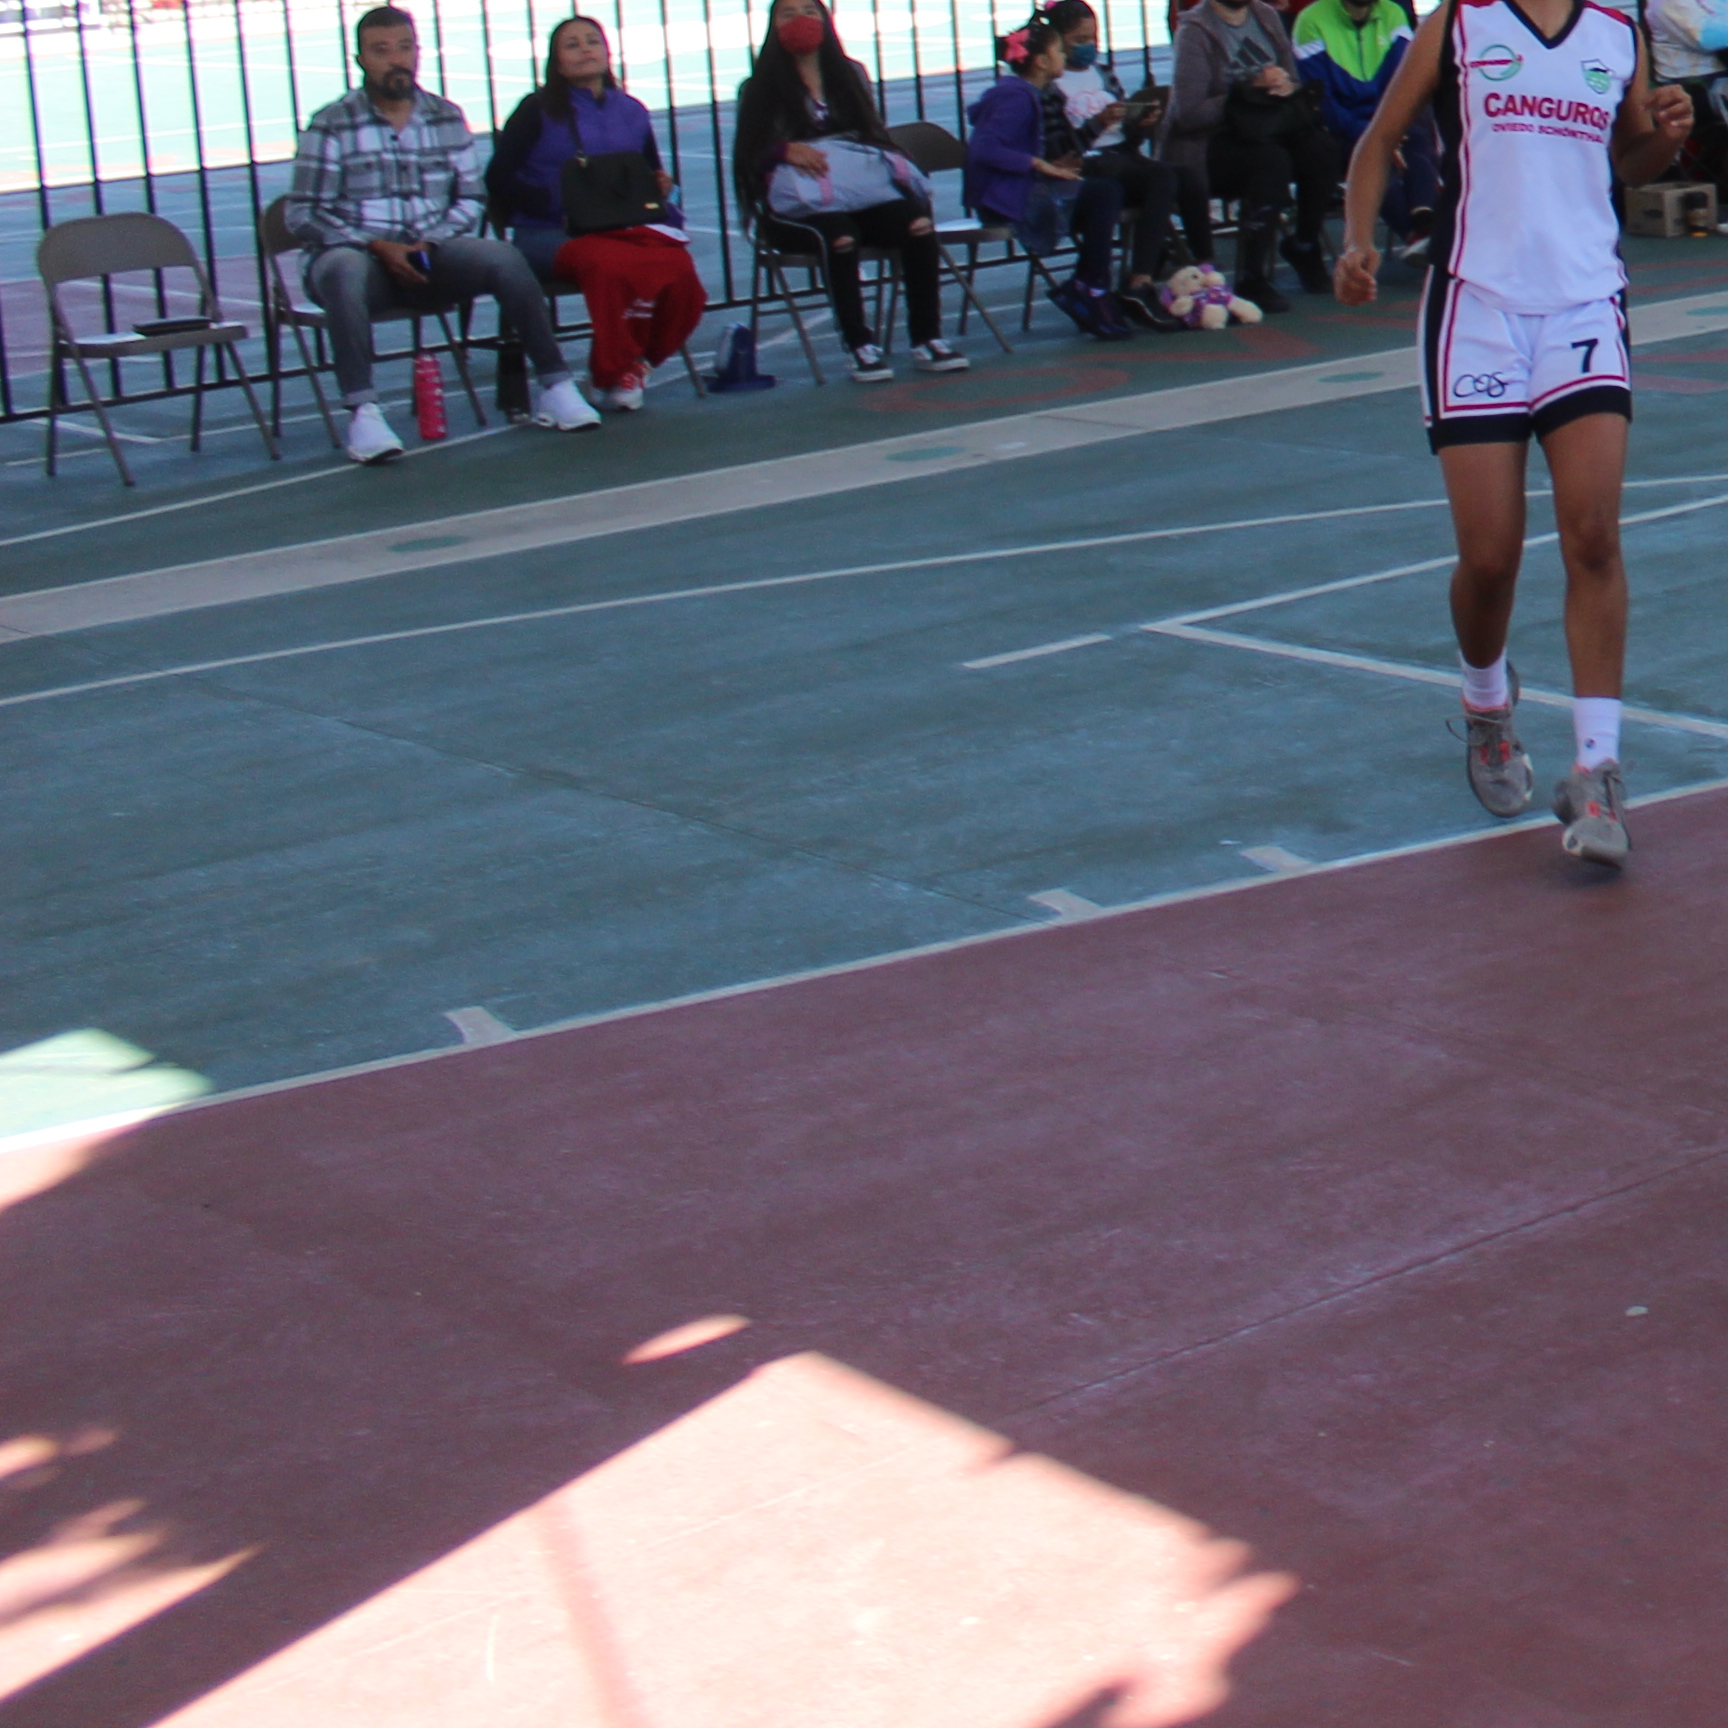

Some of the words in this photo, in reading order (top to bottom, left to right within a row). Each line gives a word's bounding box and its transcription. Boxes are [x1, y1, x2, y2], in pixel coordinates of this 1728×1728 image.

[1484, 92, 1610, 131] CANGUROS
[1571, 338, 1598, 373] 7
[1454, 372, 1508, 398] COS
